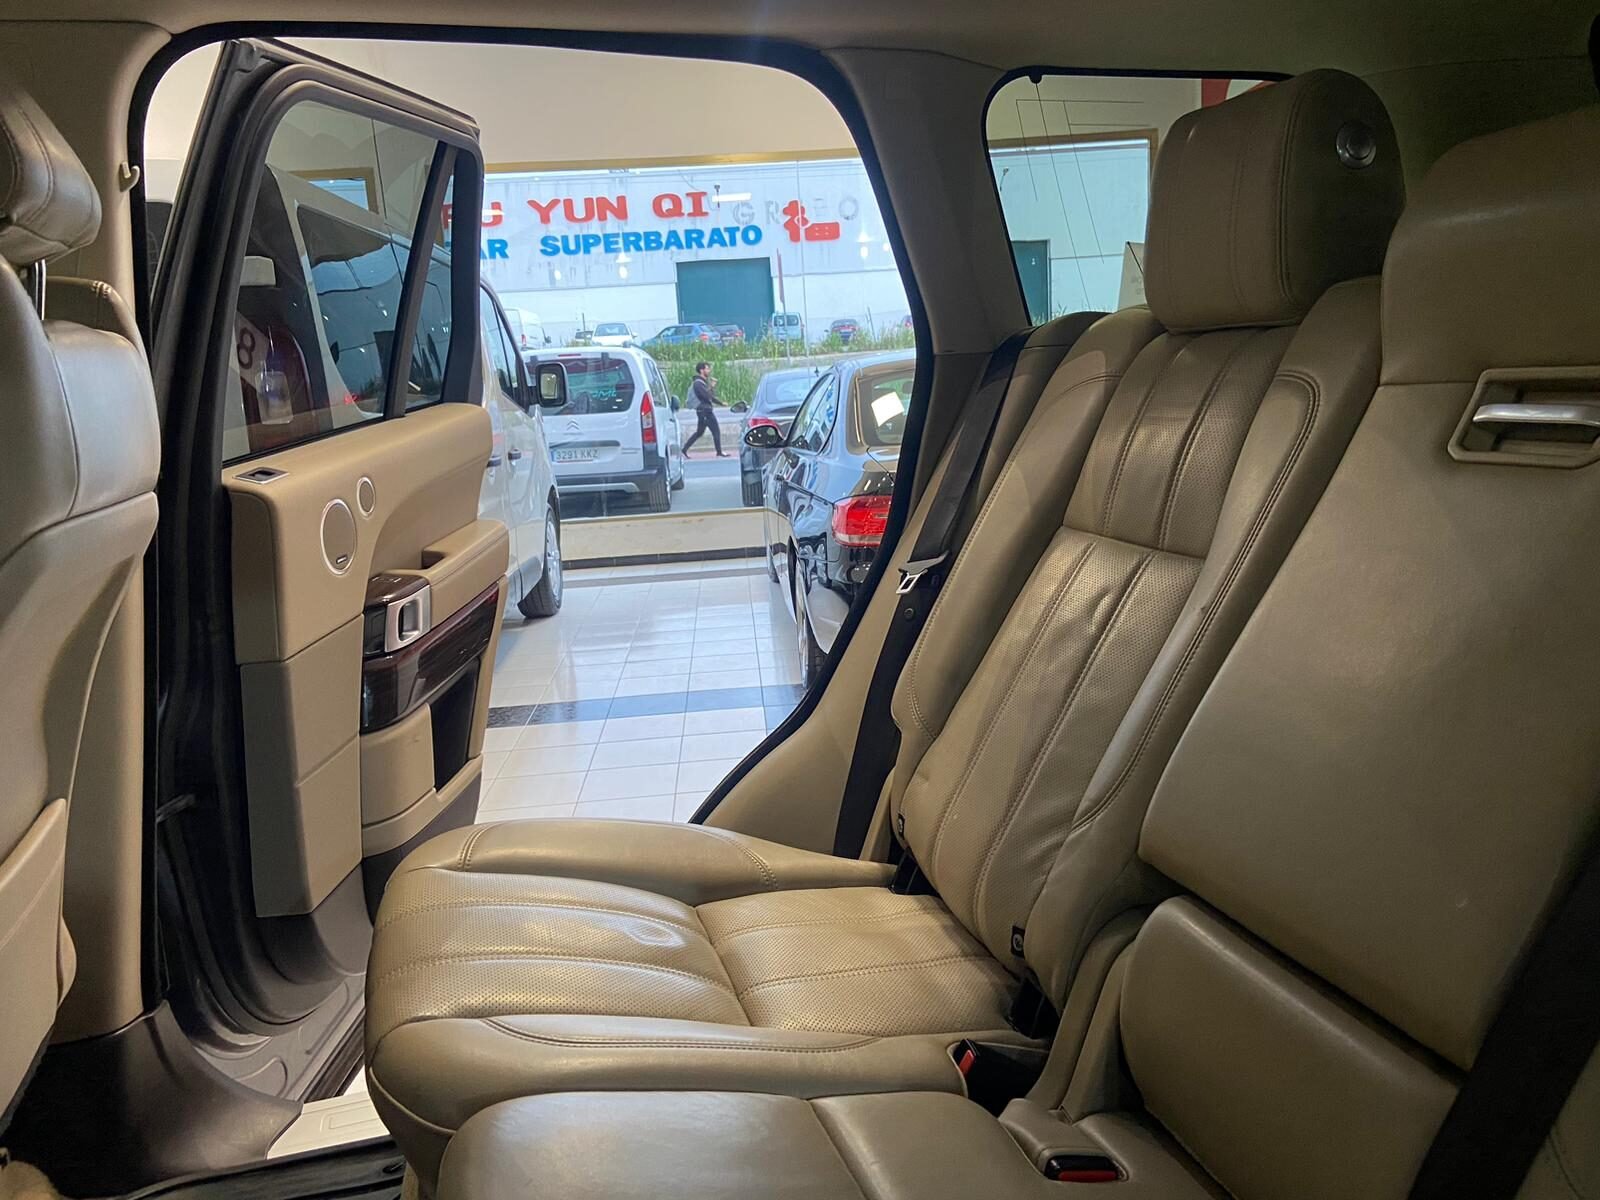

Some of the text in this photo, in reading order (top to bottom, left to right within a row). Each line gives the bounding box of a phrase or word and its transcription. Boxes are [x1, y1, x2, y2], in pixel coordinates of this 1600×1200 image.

[527, 195, 628, 225] YUN
[652, 191, 709, 218] QI
[539, 224, 763, 257] SUPERBARATO
